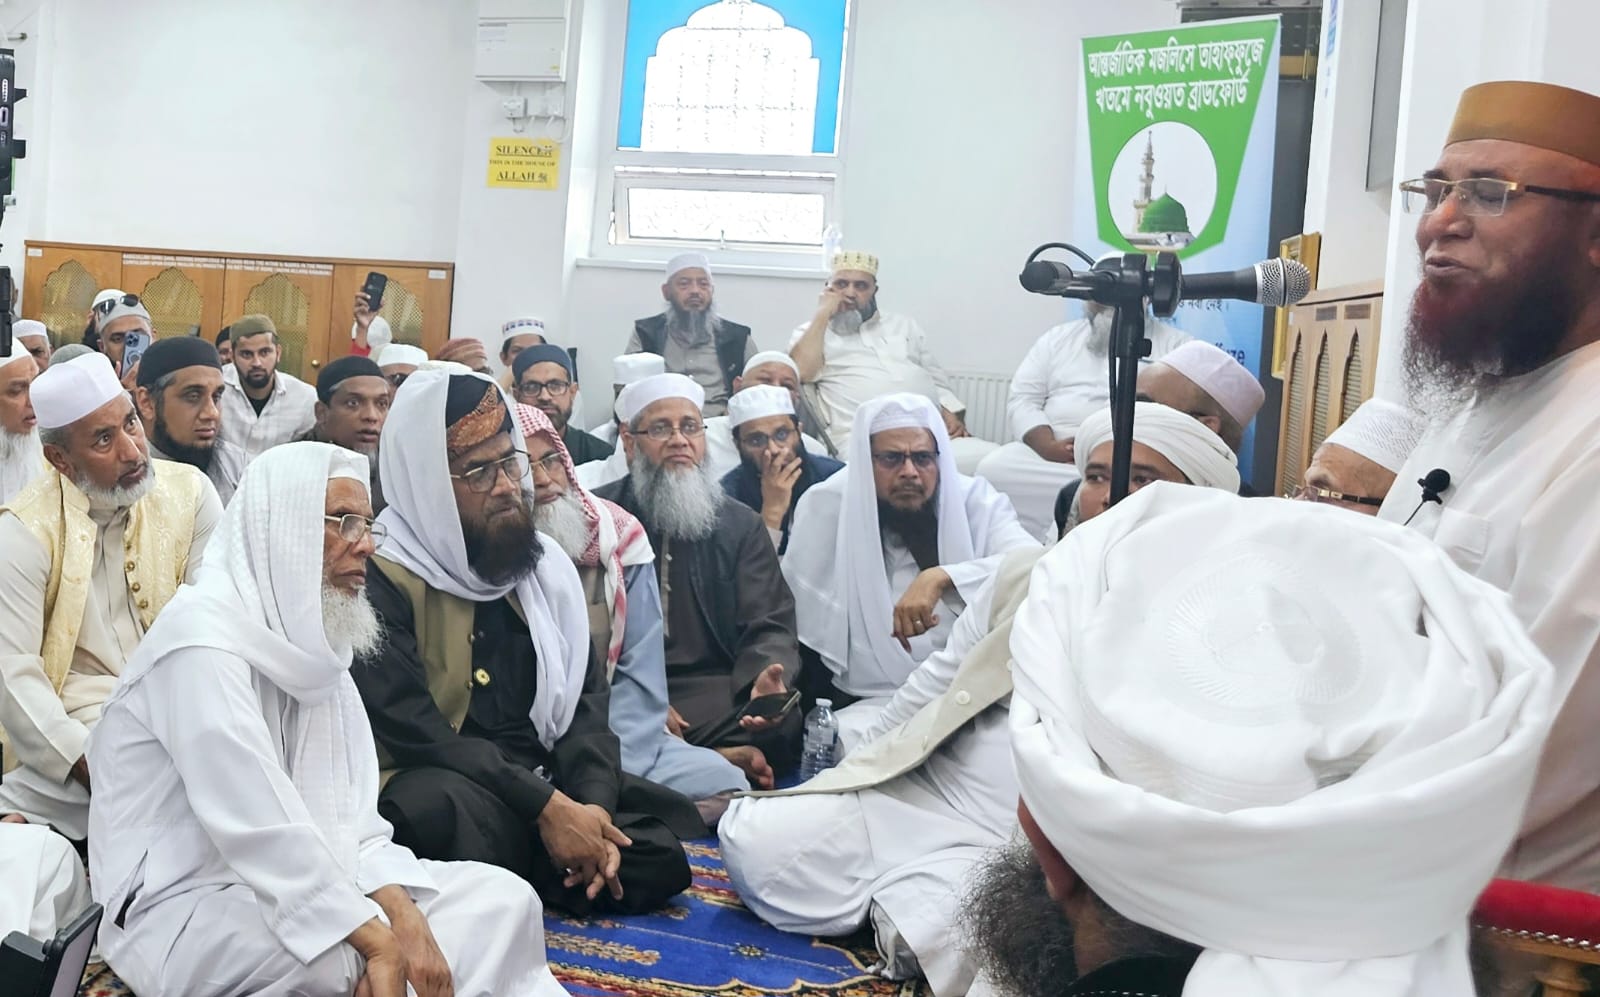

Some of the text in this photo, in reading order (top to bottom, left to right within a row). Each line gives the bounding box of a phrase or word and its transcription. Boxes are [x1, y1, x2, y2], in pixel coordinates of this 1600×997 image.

[1148, 36, 1196, 72] মজলিসে
[1096, 85, 1132, 113] খতমে
[496, 170, 535, 181] ALLAH
